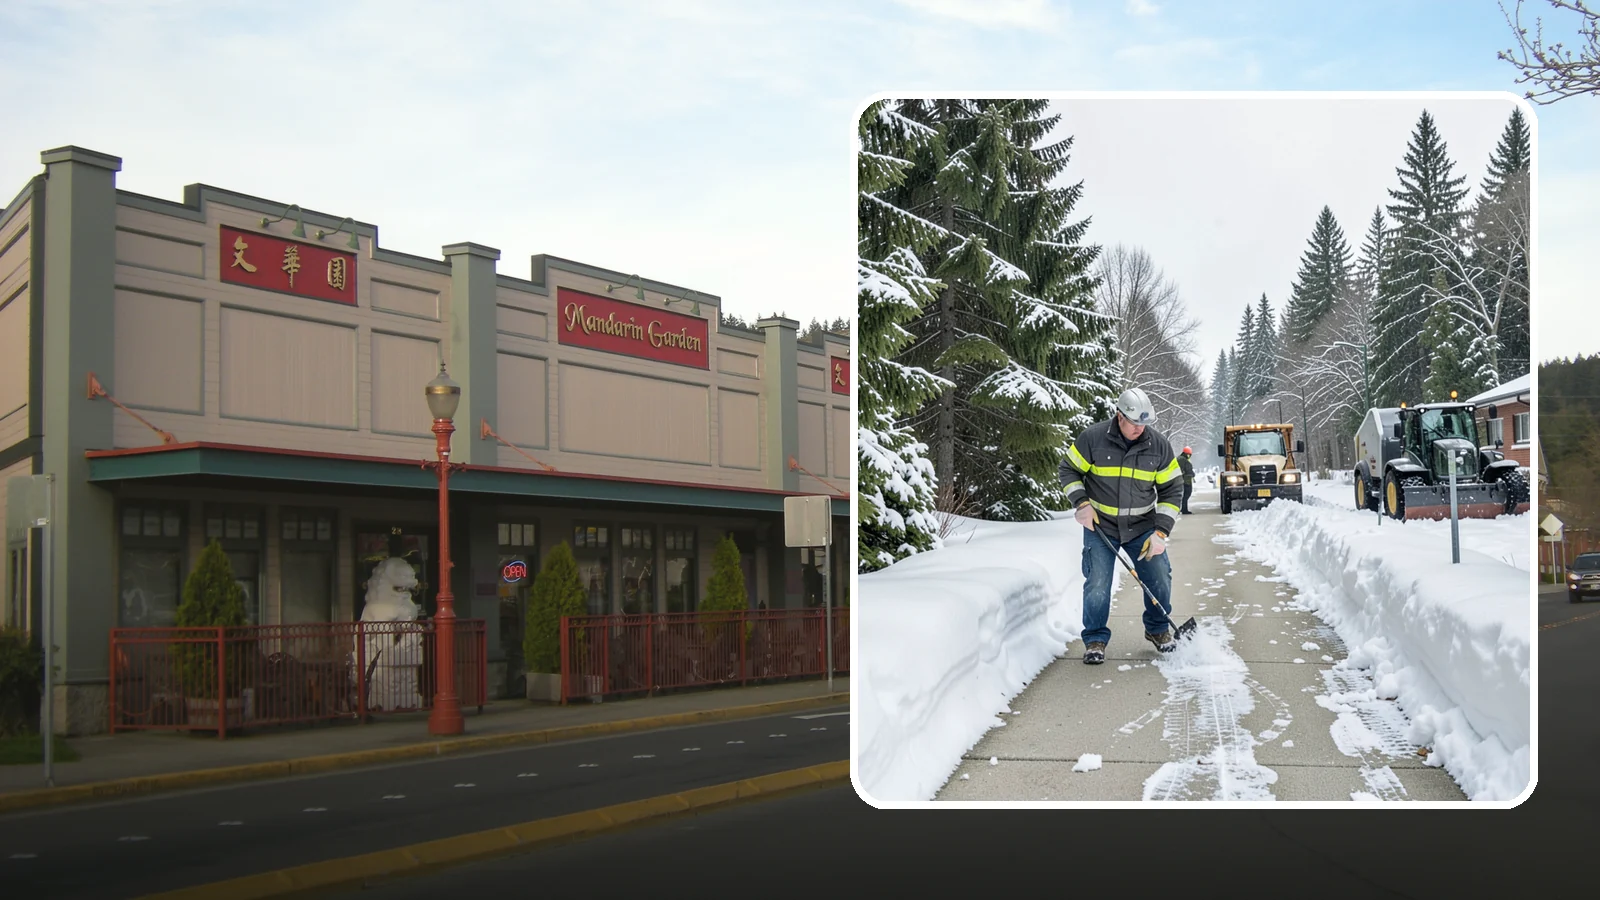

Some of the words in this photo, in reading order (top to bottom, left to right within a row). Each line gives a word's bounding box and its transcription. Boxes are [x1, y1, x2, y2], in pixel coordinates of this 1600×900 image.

[231, 236, 346, 291] 文華園
[564, 302, 644, 341] Mandarin
[648, 320, 702, 352] Garden
[503, 565, 527, 578] OPEN
